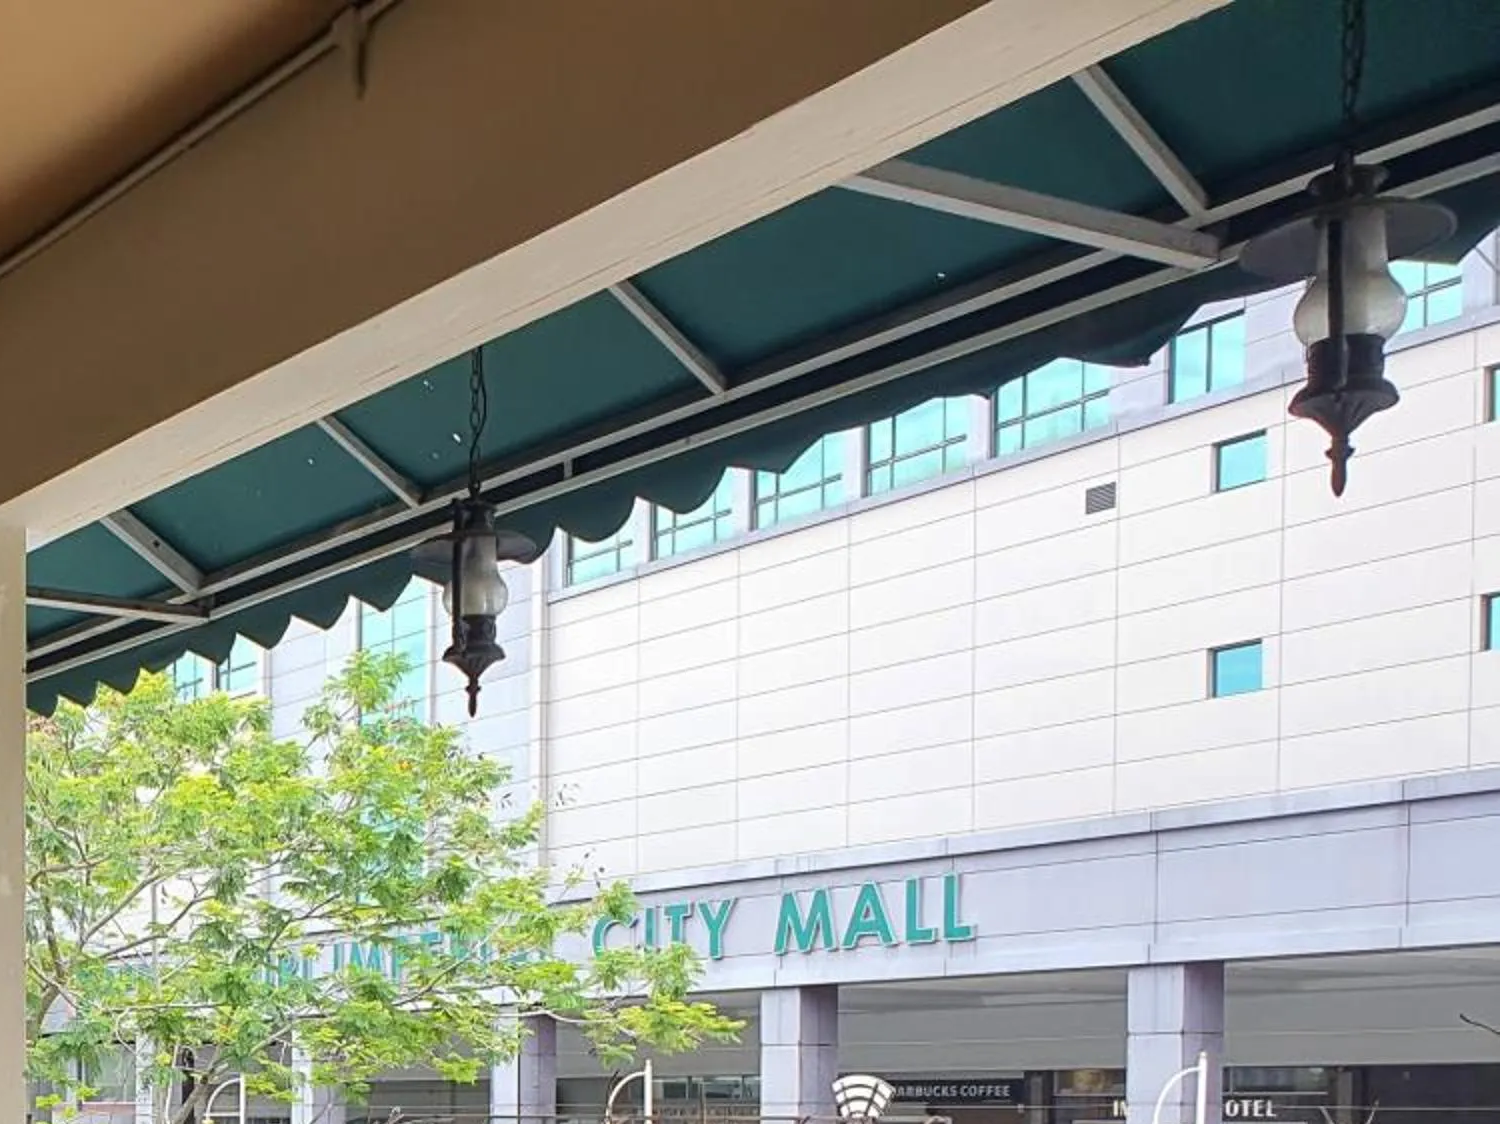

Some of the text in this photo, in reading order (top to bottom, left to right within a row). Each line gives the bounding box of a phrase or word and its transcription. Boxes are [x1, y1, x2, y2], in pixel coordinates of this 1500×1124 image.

[591, 898, 737, 960] CITY
[773, 872, 977, 955] MALL
[960, 1085, 1011, 1097] COFFEE
[1224, 1100, 1277, 1117] OTEL
